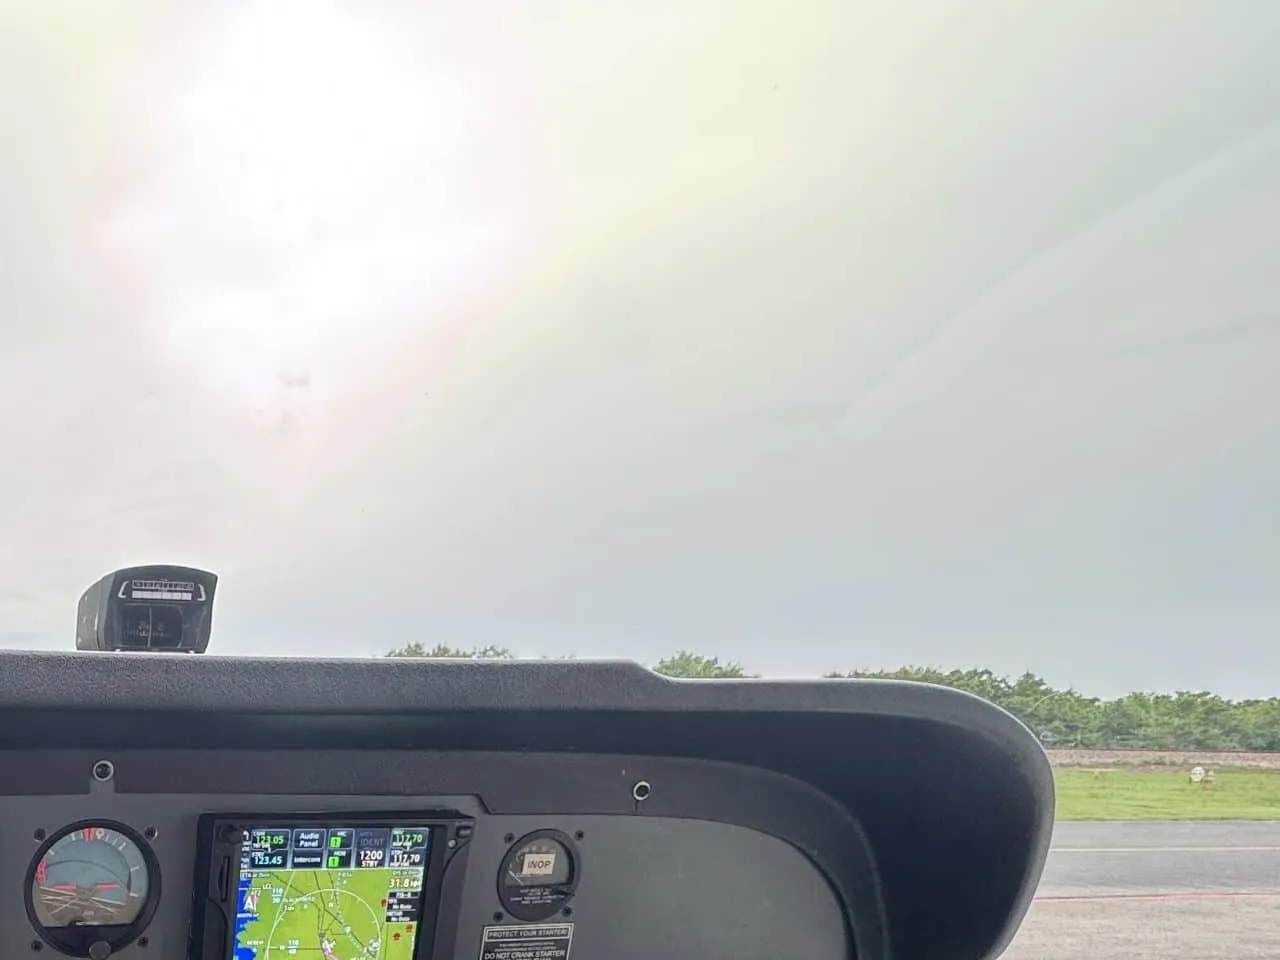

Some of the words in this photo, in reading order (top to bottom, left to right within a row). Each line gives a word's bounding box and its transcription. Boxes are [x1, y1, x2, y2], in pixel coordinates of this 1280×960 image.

[256, 836, 284, 844] 123.05
[360, 850, 383, 860] 1200
[255, 856, 282, 864] 123.45
[528, 860, 551, 868] INOP
